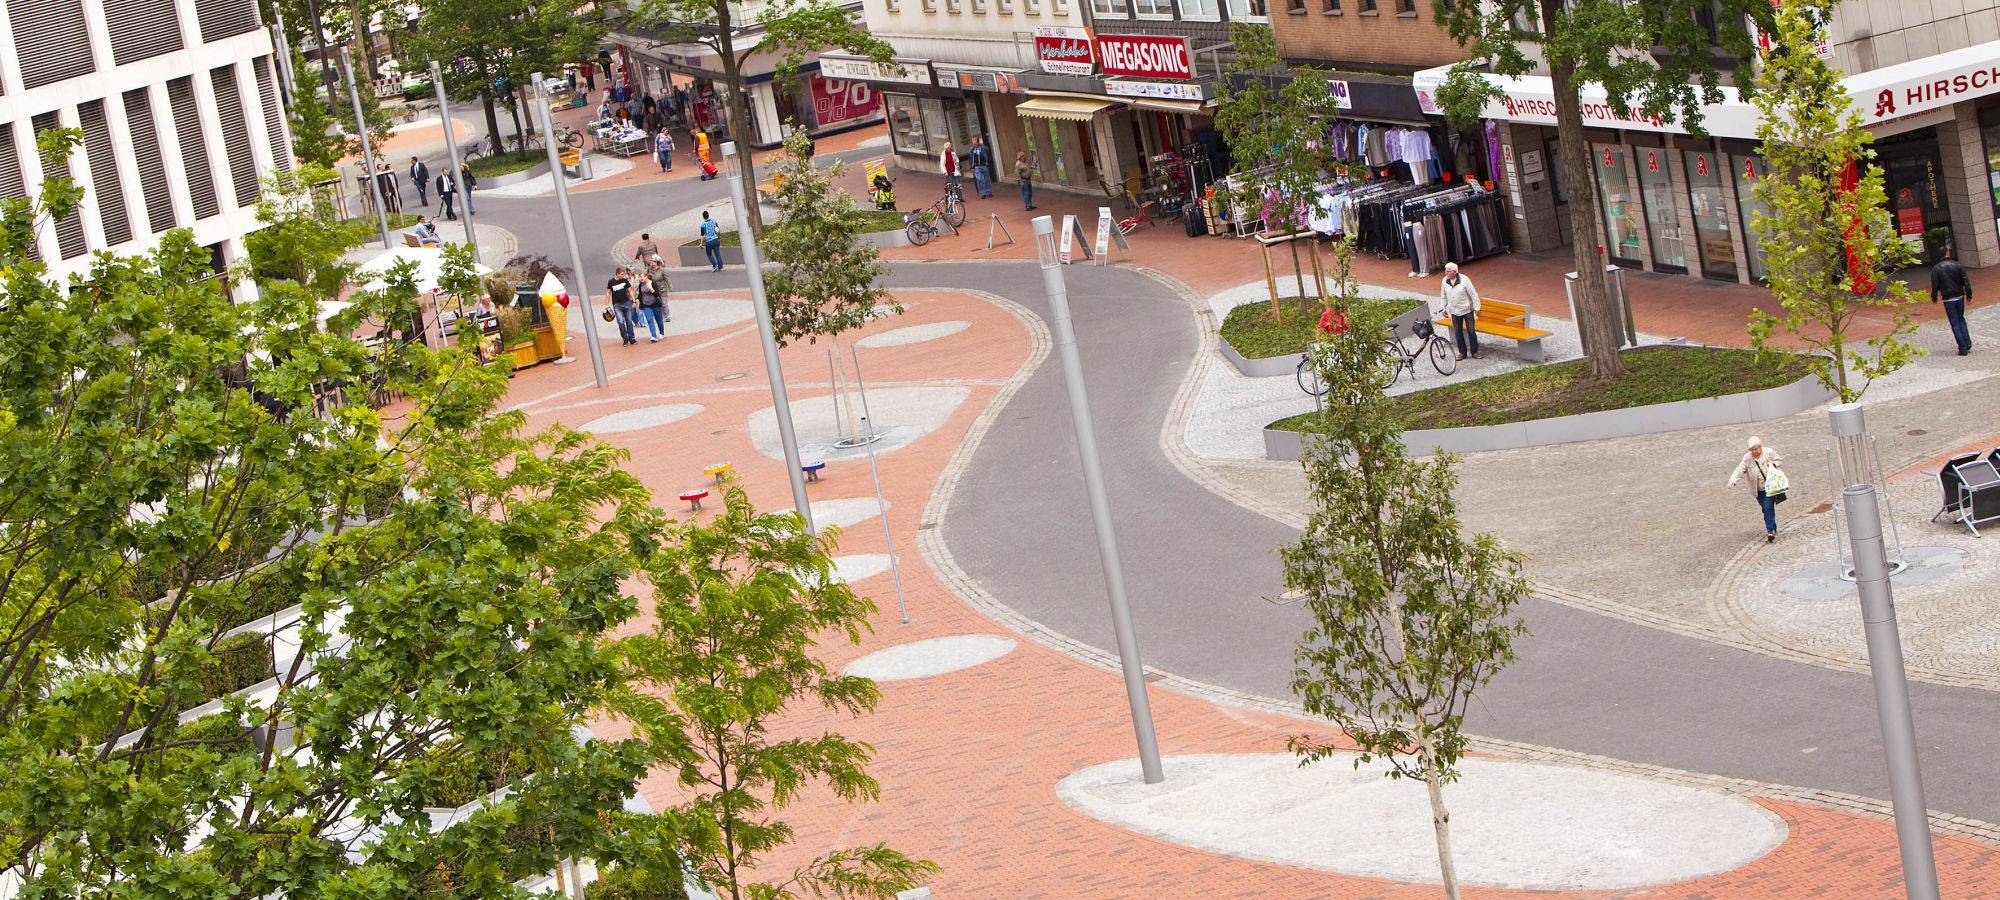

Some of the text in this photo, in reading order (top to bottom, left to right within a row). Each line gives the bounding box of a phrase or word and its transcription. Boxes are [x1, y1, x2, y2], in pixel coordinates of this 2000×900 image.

[1040, 38, 1089, 60] Merhaba
[1100, 41, 1189, 74] MEGASONIC
[1047, 62, 1090, 74] Schnellrestaurant
[1515, 99, 1557, 116] HIRSC
